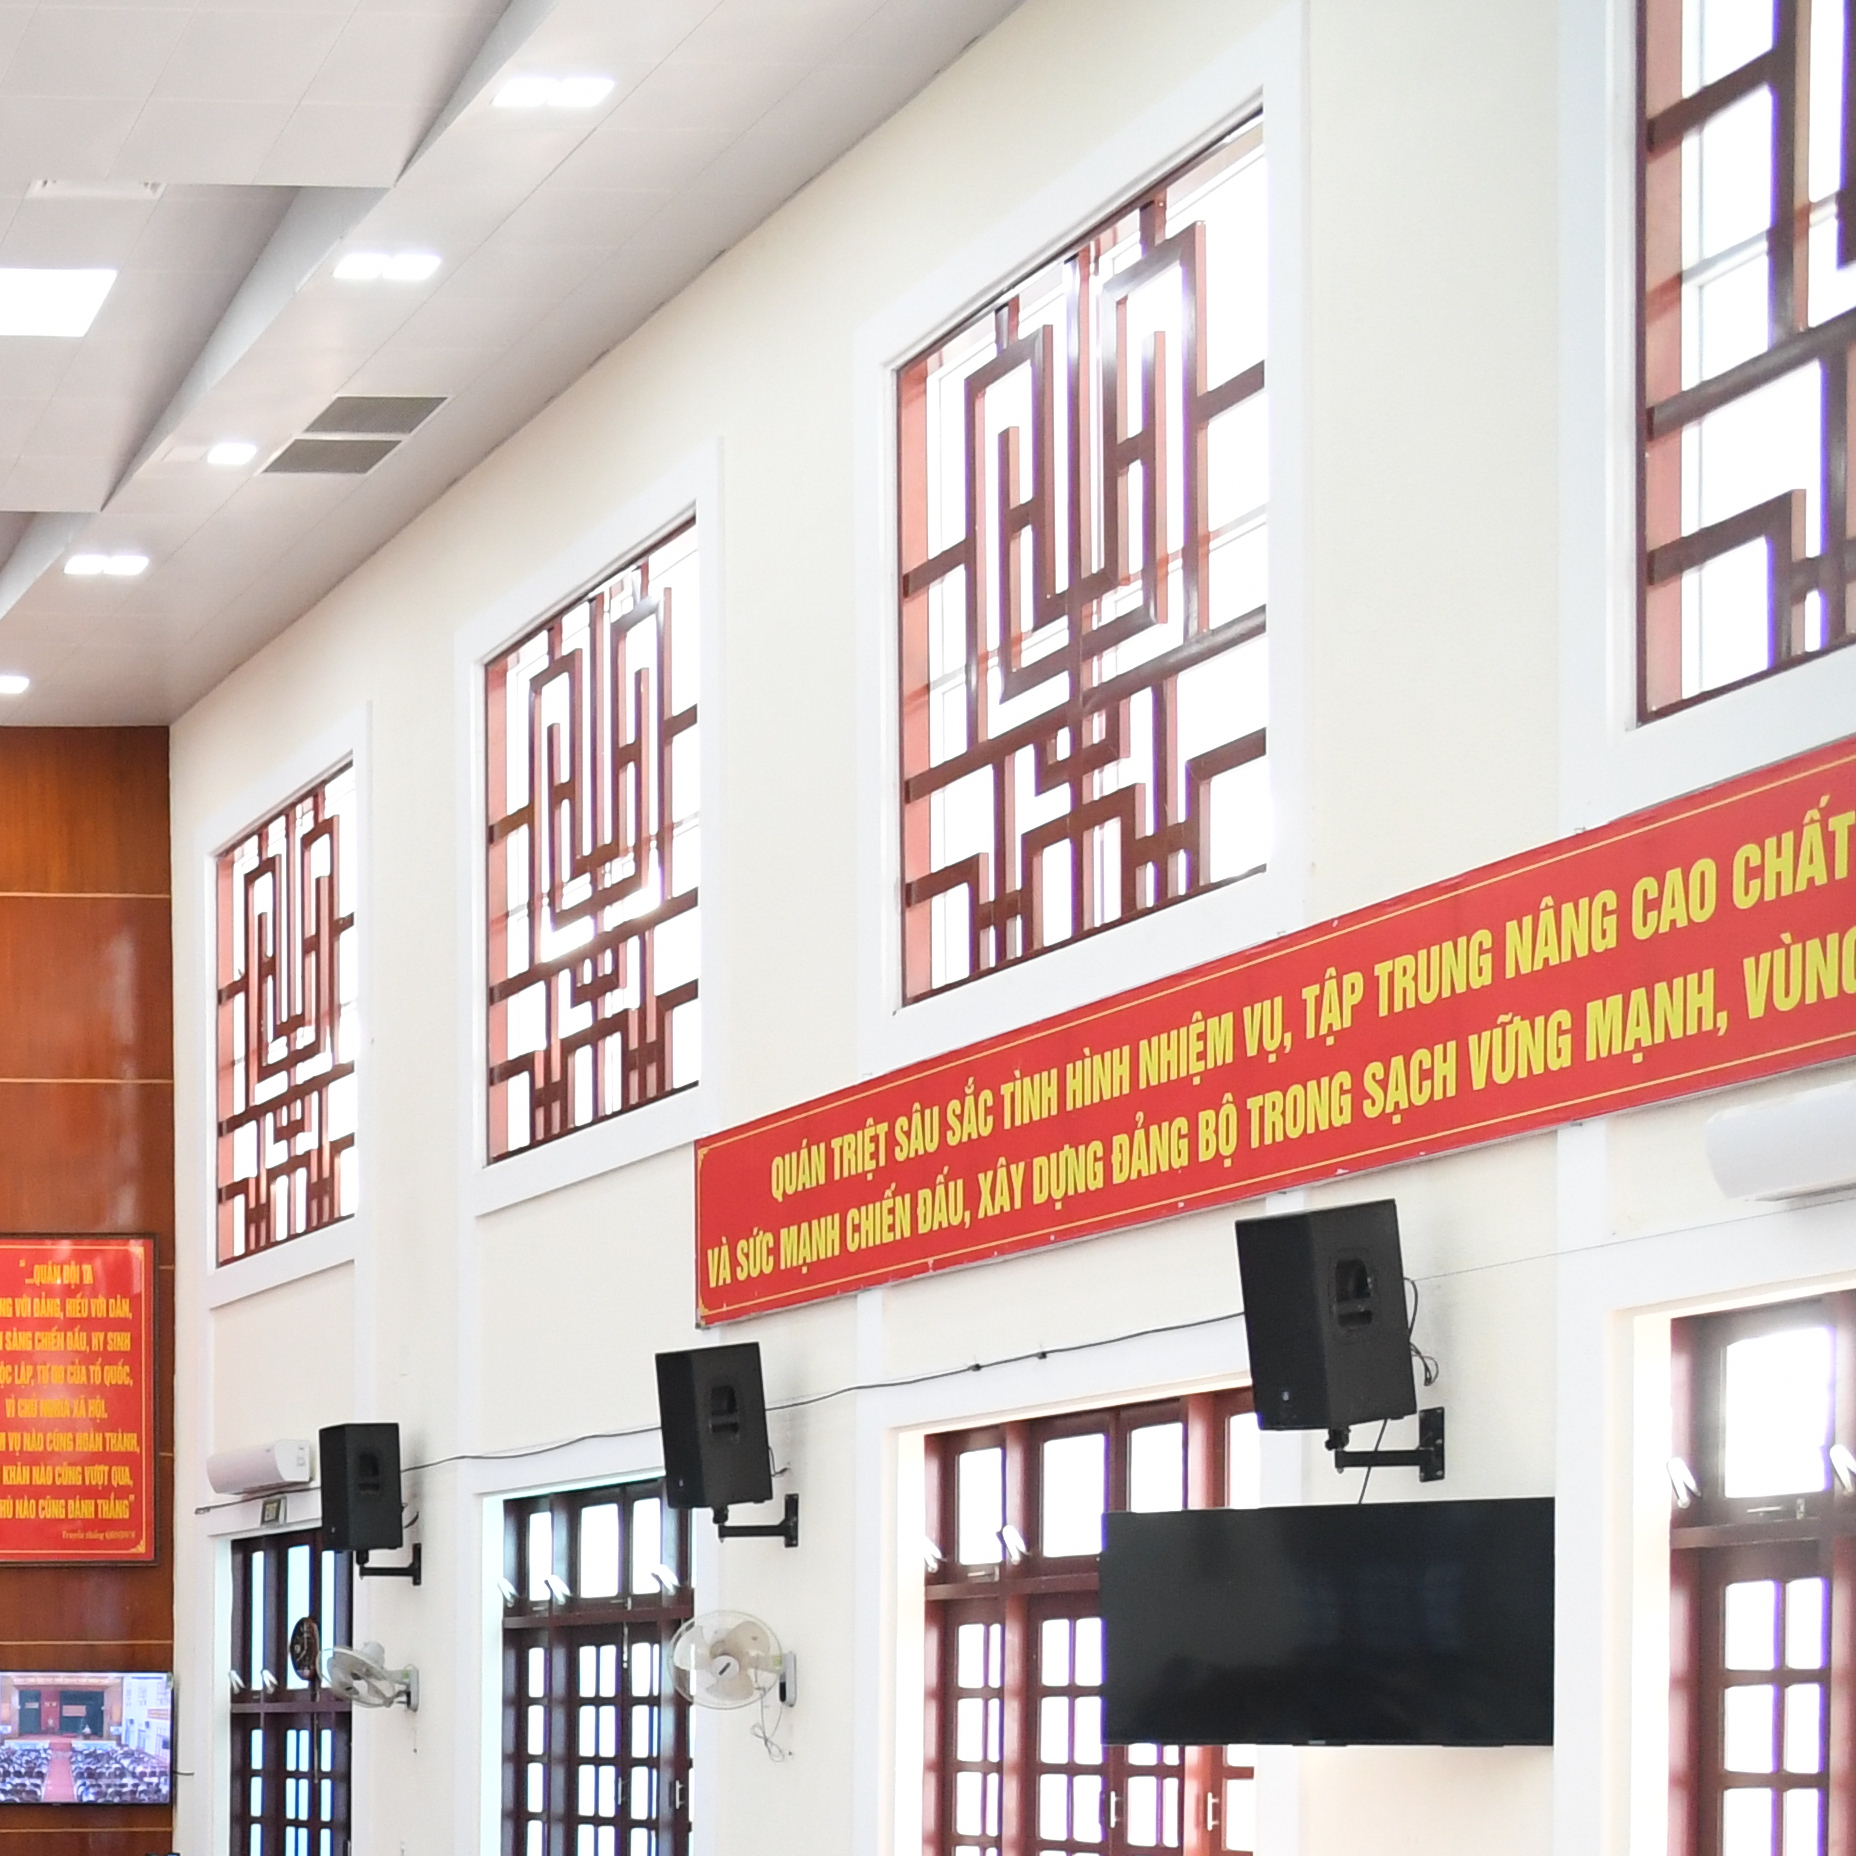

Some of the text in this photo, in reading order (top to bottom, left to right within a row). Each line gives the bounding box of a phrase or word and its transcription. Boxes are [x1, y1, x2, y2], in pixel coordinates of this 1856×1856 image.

[708, 1237, 731, 1287] VÀ
[737, 1228, 774, 1280] SỨC
[781, 1214, 840, 1273] MẠNH
[847, 1183, 911, 1251] CHIẾN
[917, 1167, 970, 1233] ĐẤU,
[978, 1157, 1025, 1218] XÂY
[1033, 1141, 1103, 1210] DỰNG
[1112, 1112, 1188, 1184] ĐẢNG
[1199, 1093, 1237, 1167] BỘ
[1247, 1071, 1351, 1148] TRONG
[1363, 1041, 1456, 1124] SẠCH
[1468, 1009, 1571, 1090] VỮNG
[1586, 968, 1728, 1063] MẠNH,
[772, 795, 1856, 1202] QUÁN TRIỆT SÂU SẮC TÌNH HÌNH NHIỆM VỤ, TẬP TRUNG NÂNG CAO CHẤT
